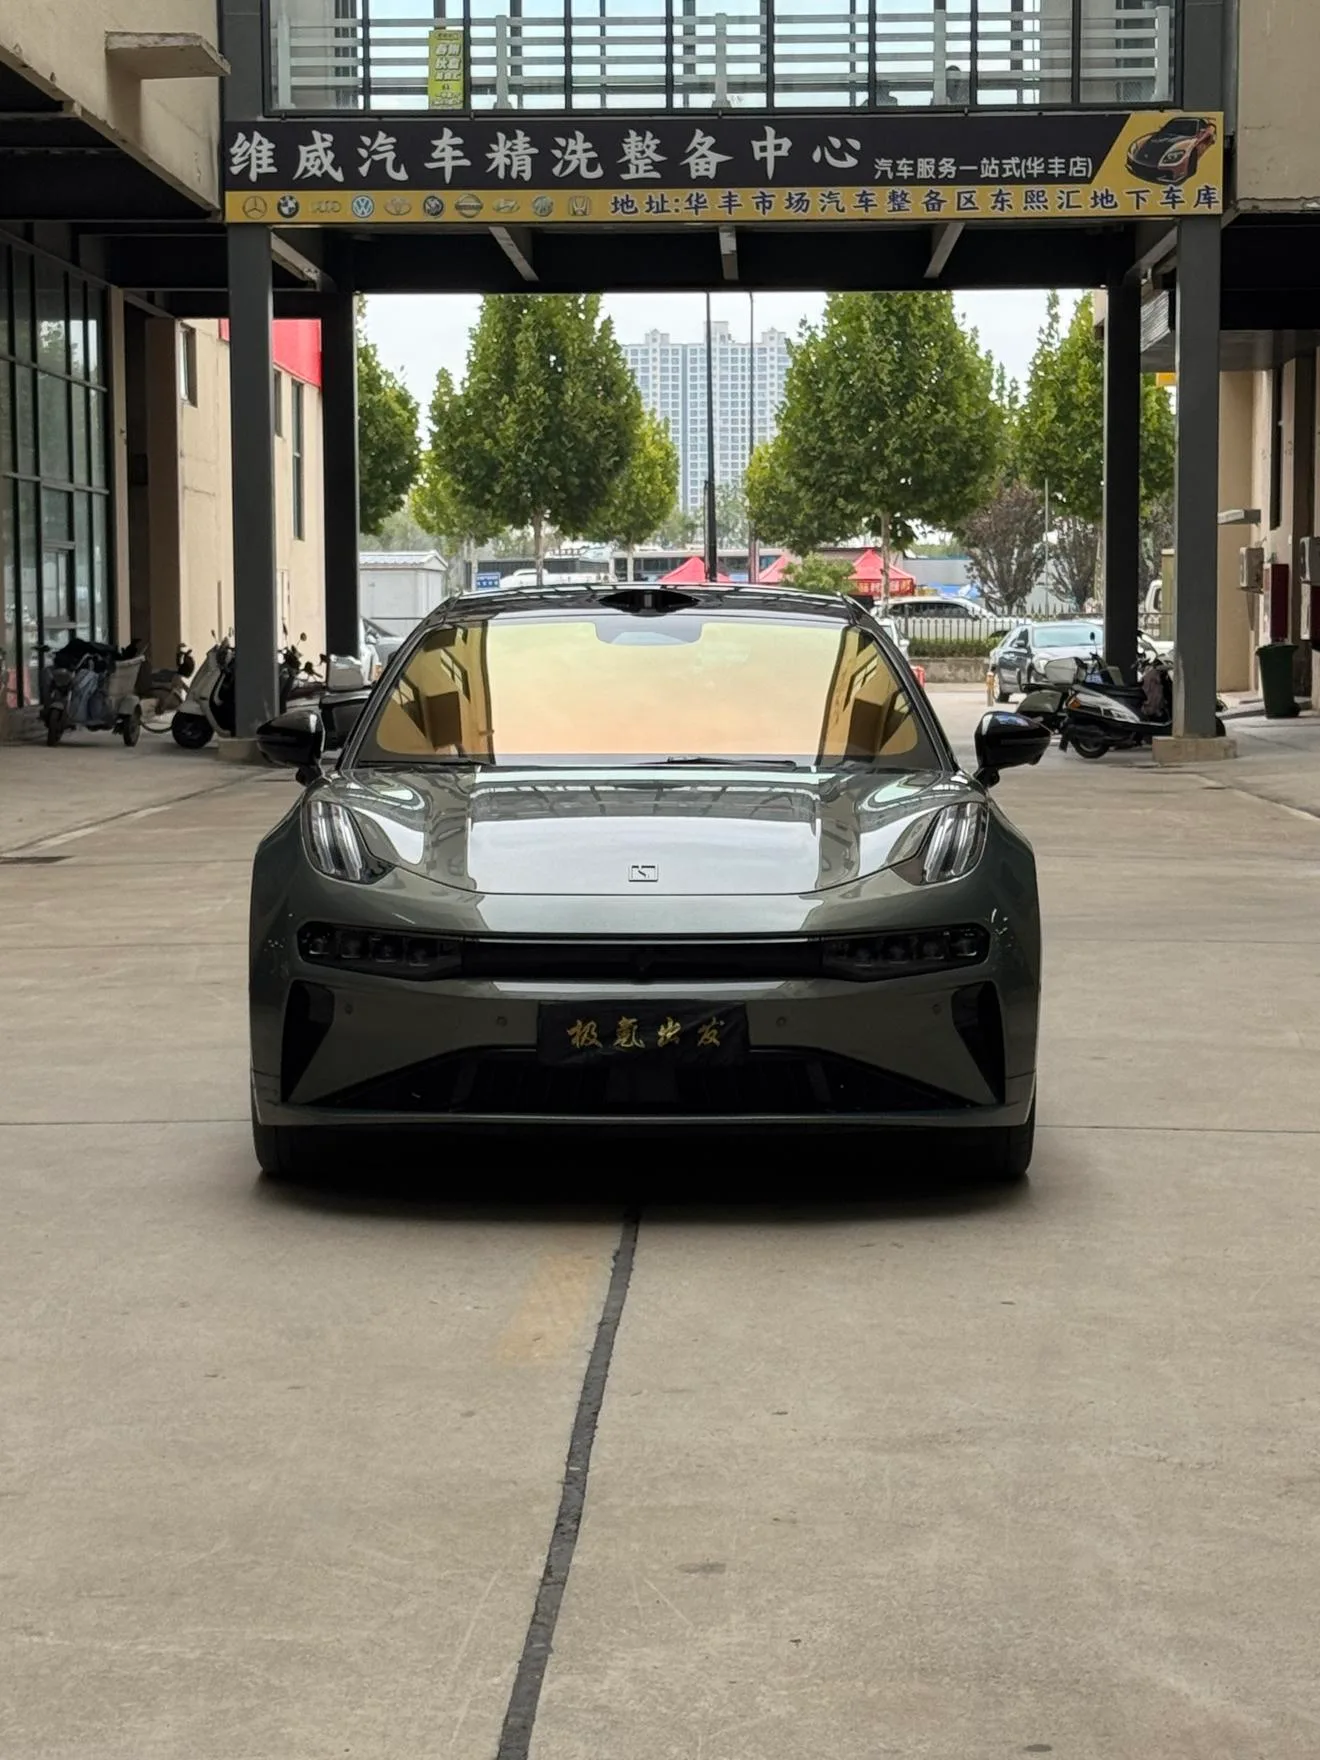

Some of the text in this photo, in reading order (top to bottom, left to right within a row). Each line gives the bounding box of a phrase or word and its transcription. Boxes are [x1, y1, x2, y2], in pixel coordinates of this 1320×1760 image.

[229, 126, 861, 184] 维威汽车精洗整备中心
[874, 156, 1093, 180] 汽车服务一站式(华丰店)
[610, 185, 1220, 216] 地址:华丰市场汽车整备区东熙汇地下车库
